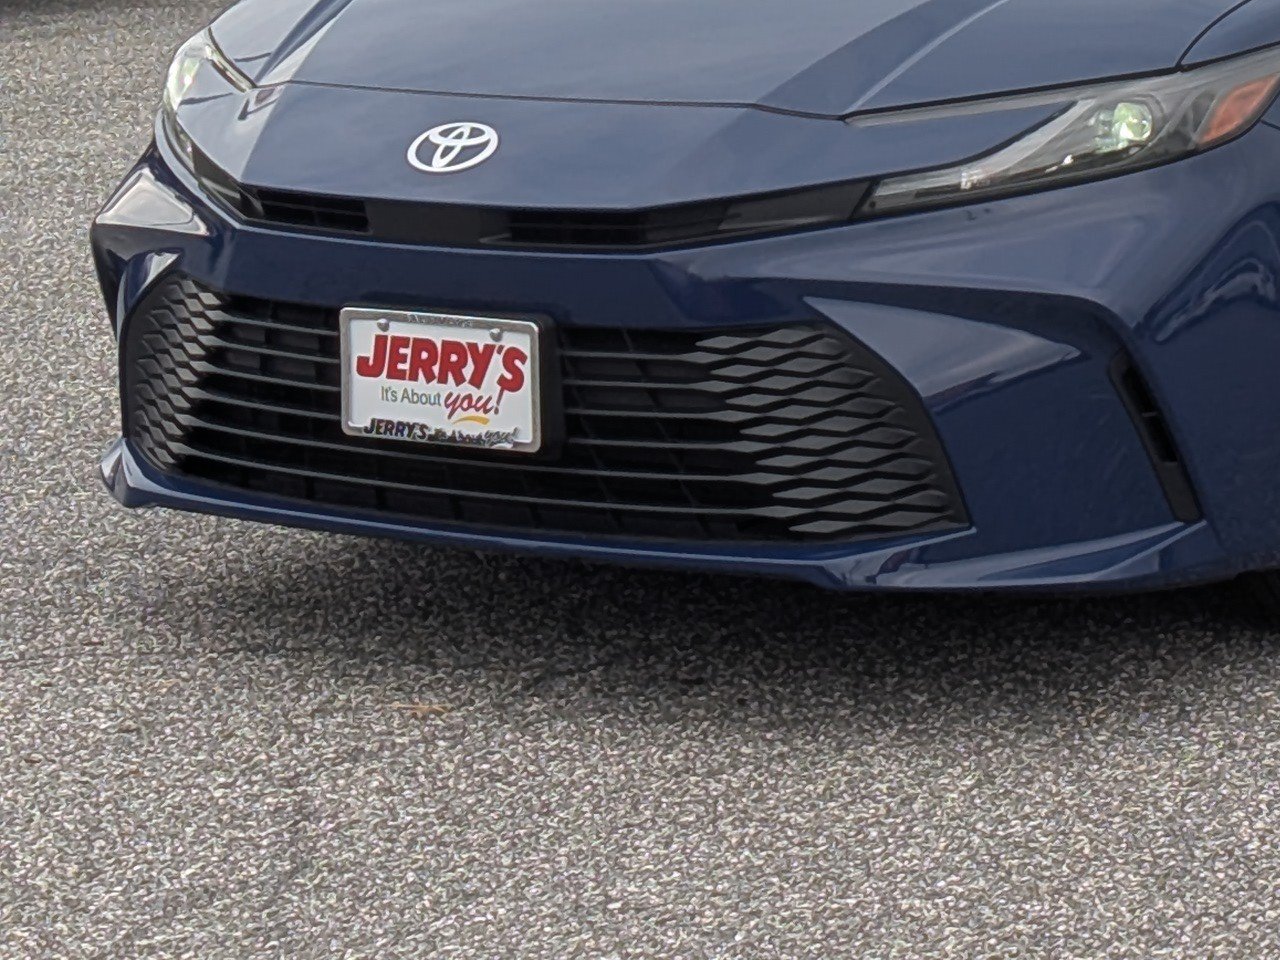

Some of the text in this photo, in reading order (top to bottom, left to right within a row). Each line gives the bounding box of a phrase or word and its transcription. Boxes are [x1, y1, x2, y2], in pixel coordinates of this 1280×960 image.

[356, 334, 528, 393] JERRY'S
[381, 386, 506, 420] It's About you!
